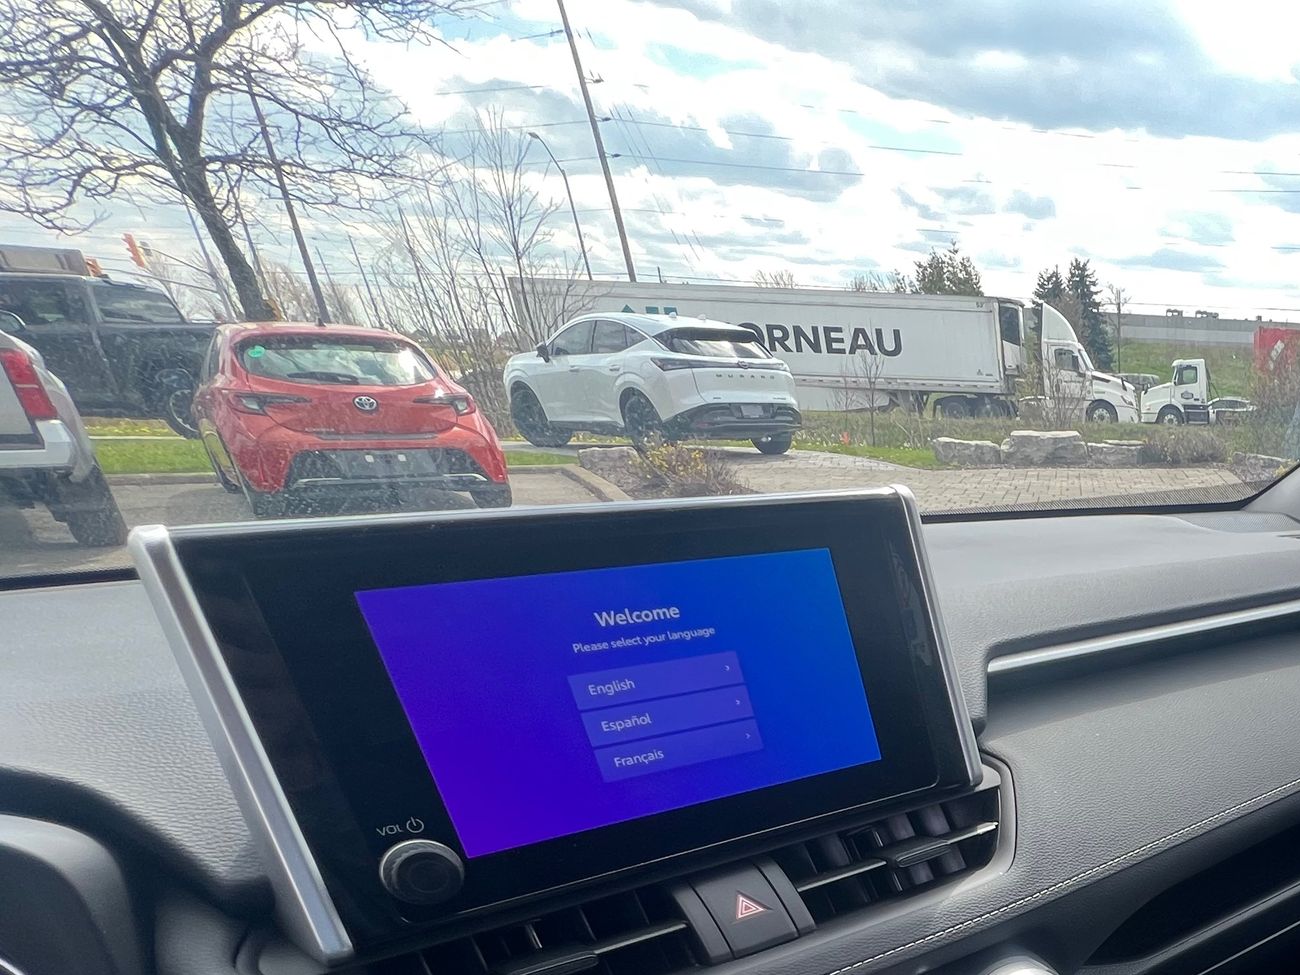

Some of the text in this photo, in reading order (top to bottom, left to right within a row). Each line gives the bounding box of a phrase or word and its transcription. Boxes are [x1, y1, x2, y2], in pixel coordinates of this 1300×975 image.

[594, 606, 680, 627] Welcome
[572, 627, 716, 653] Please select your language
[588, 679, 636, 696] English
[601, 712, 652, 732] Español
[613, 749, 664, 768] Français
[376, 824, 404, 836] VOL
